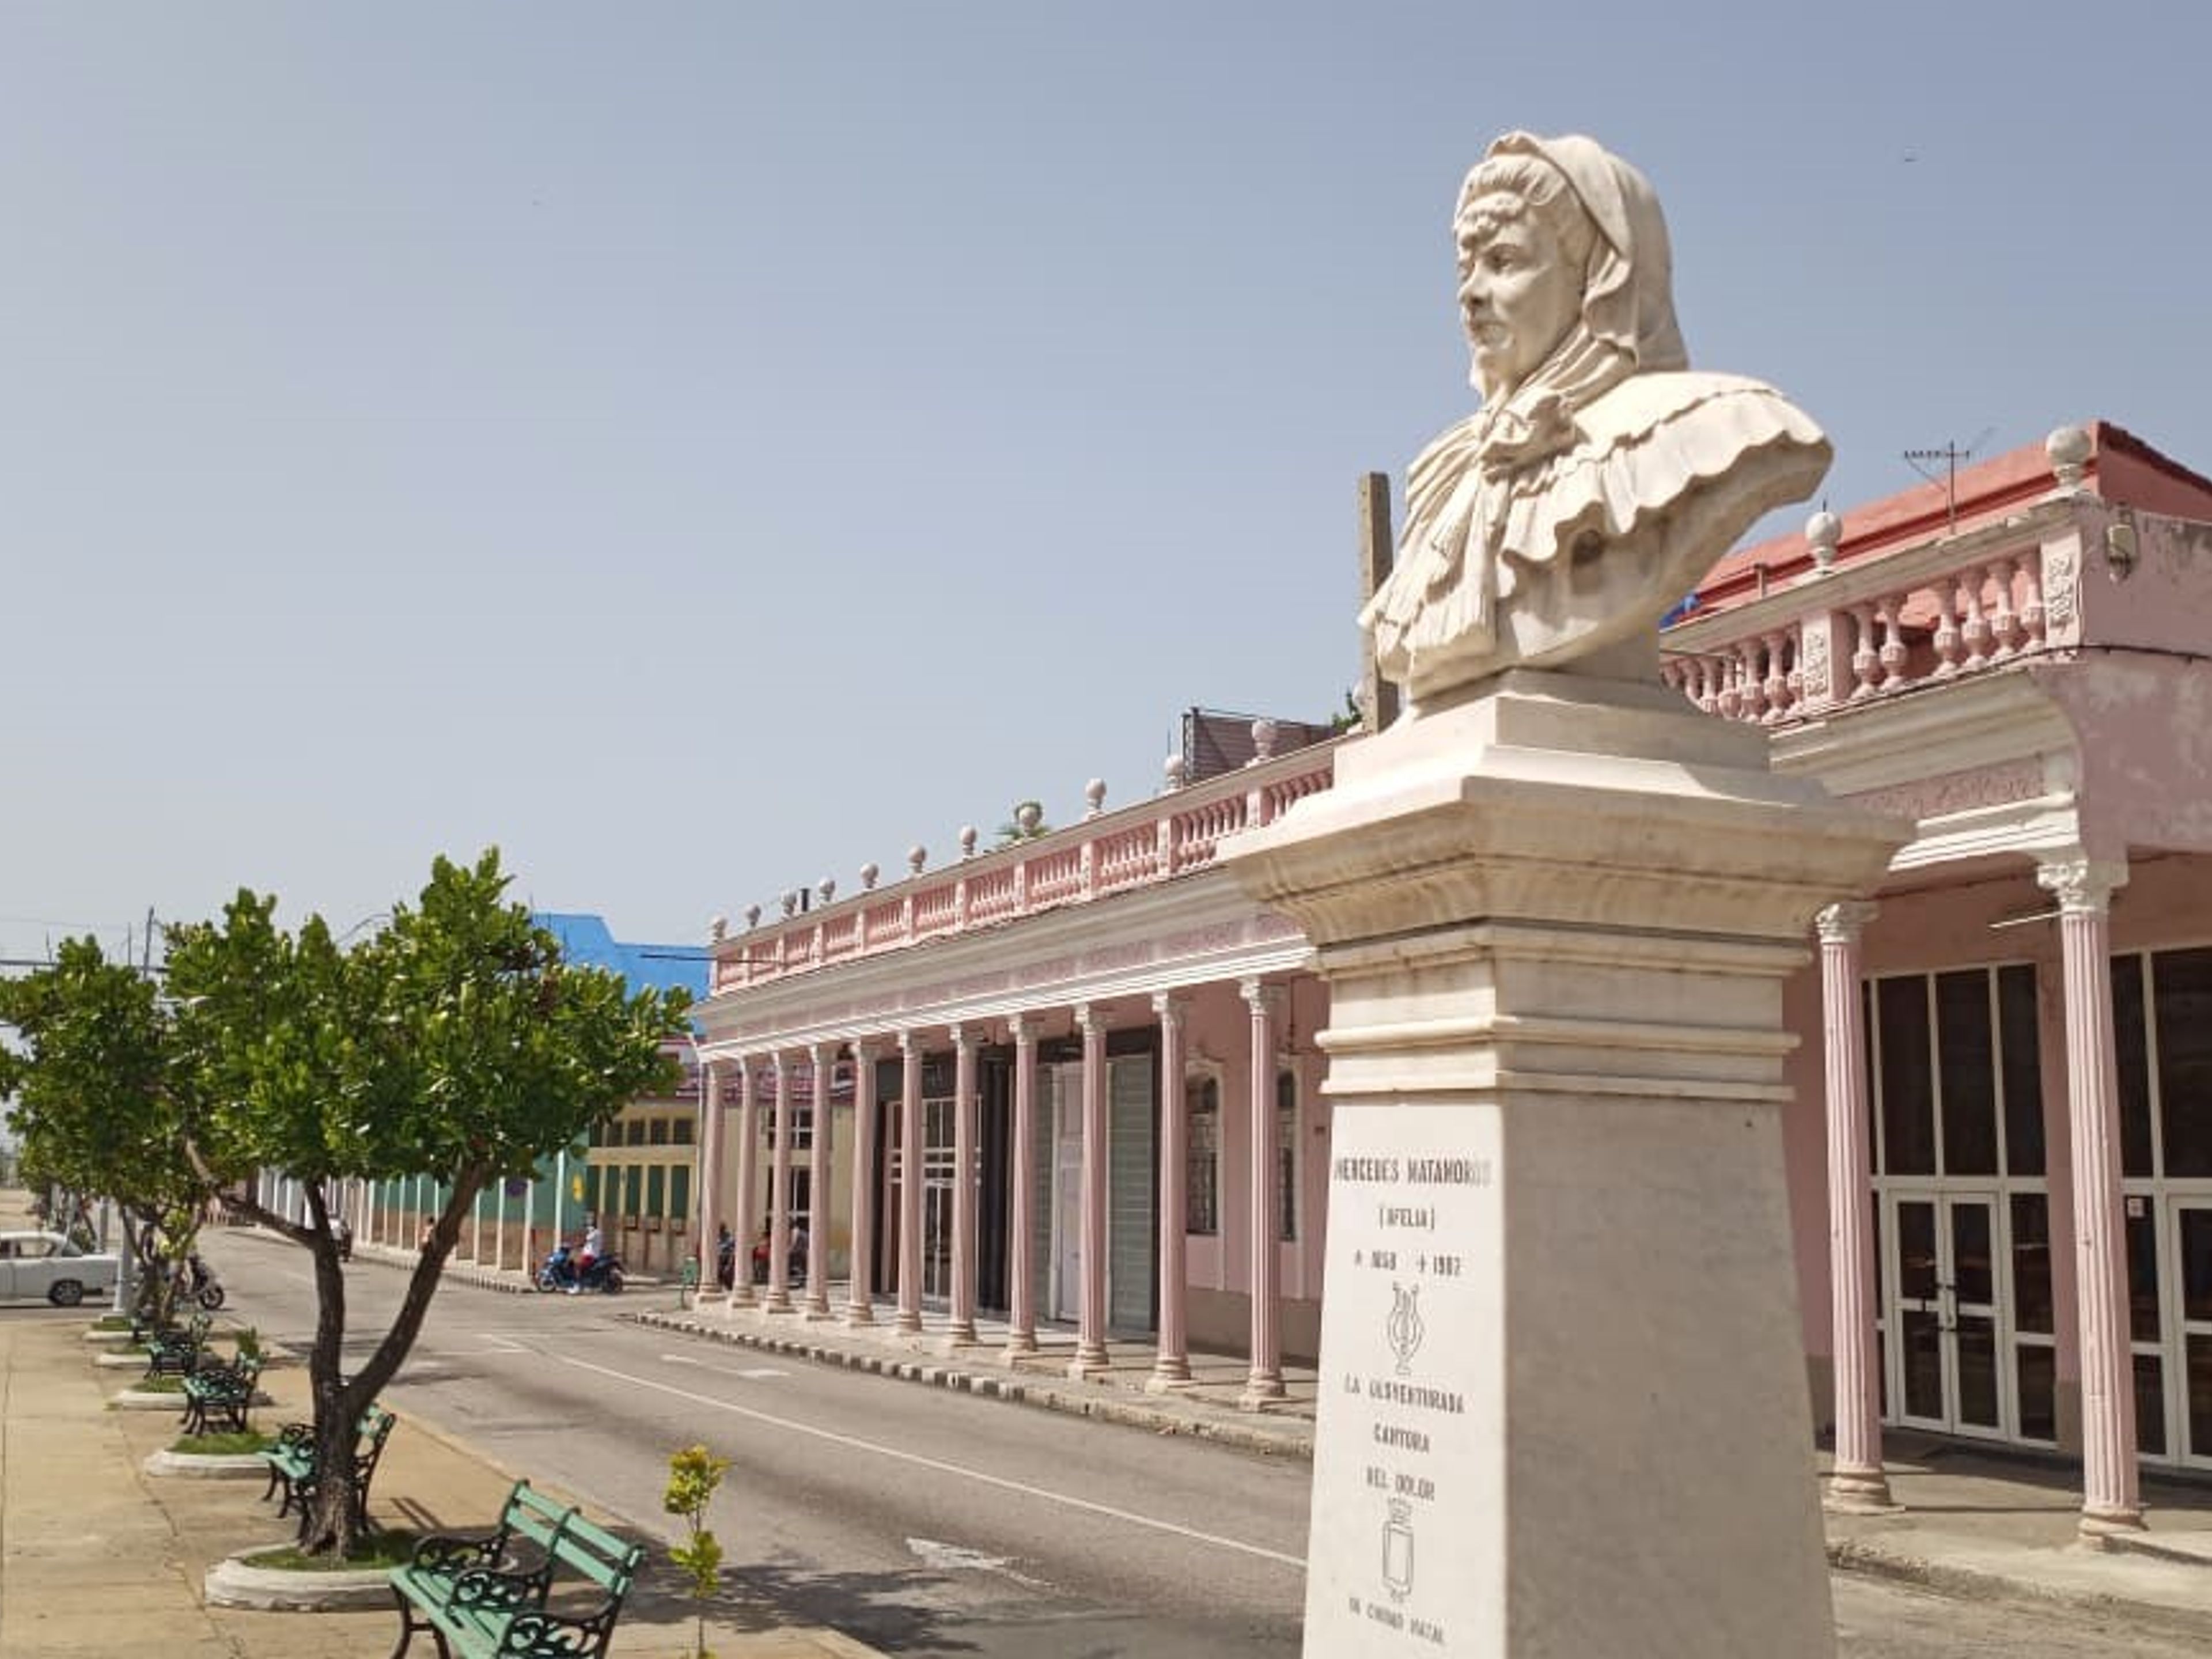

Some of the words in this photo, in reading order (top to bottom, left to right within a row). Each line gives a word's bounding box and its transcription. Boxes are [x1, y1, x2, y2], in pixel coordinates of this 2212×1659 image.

[1335, 1157, 1399, 1181] MERCEDES
[1344, 1373, 1361, 1393] LA
[1374, 1423, 1430, 1453] CANTORA
[1395, 1474, 1435, 1501] DOLOR
